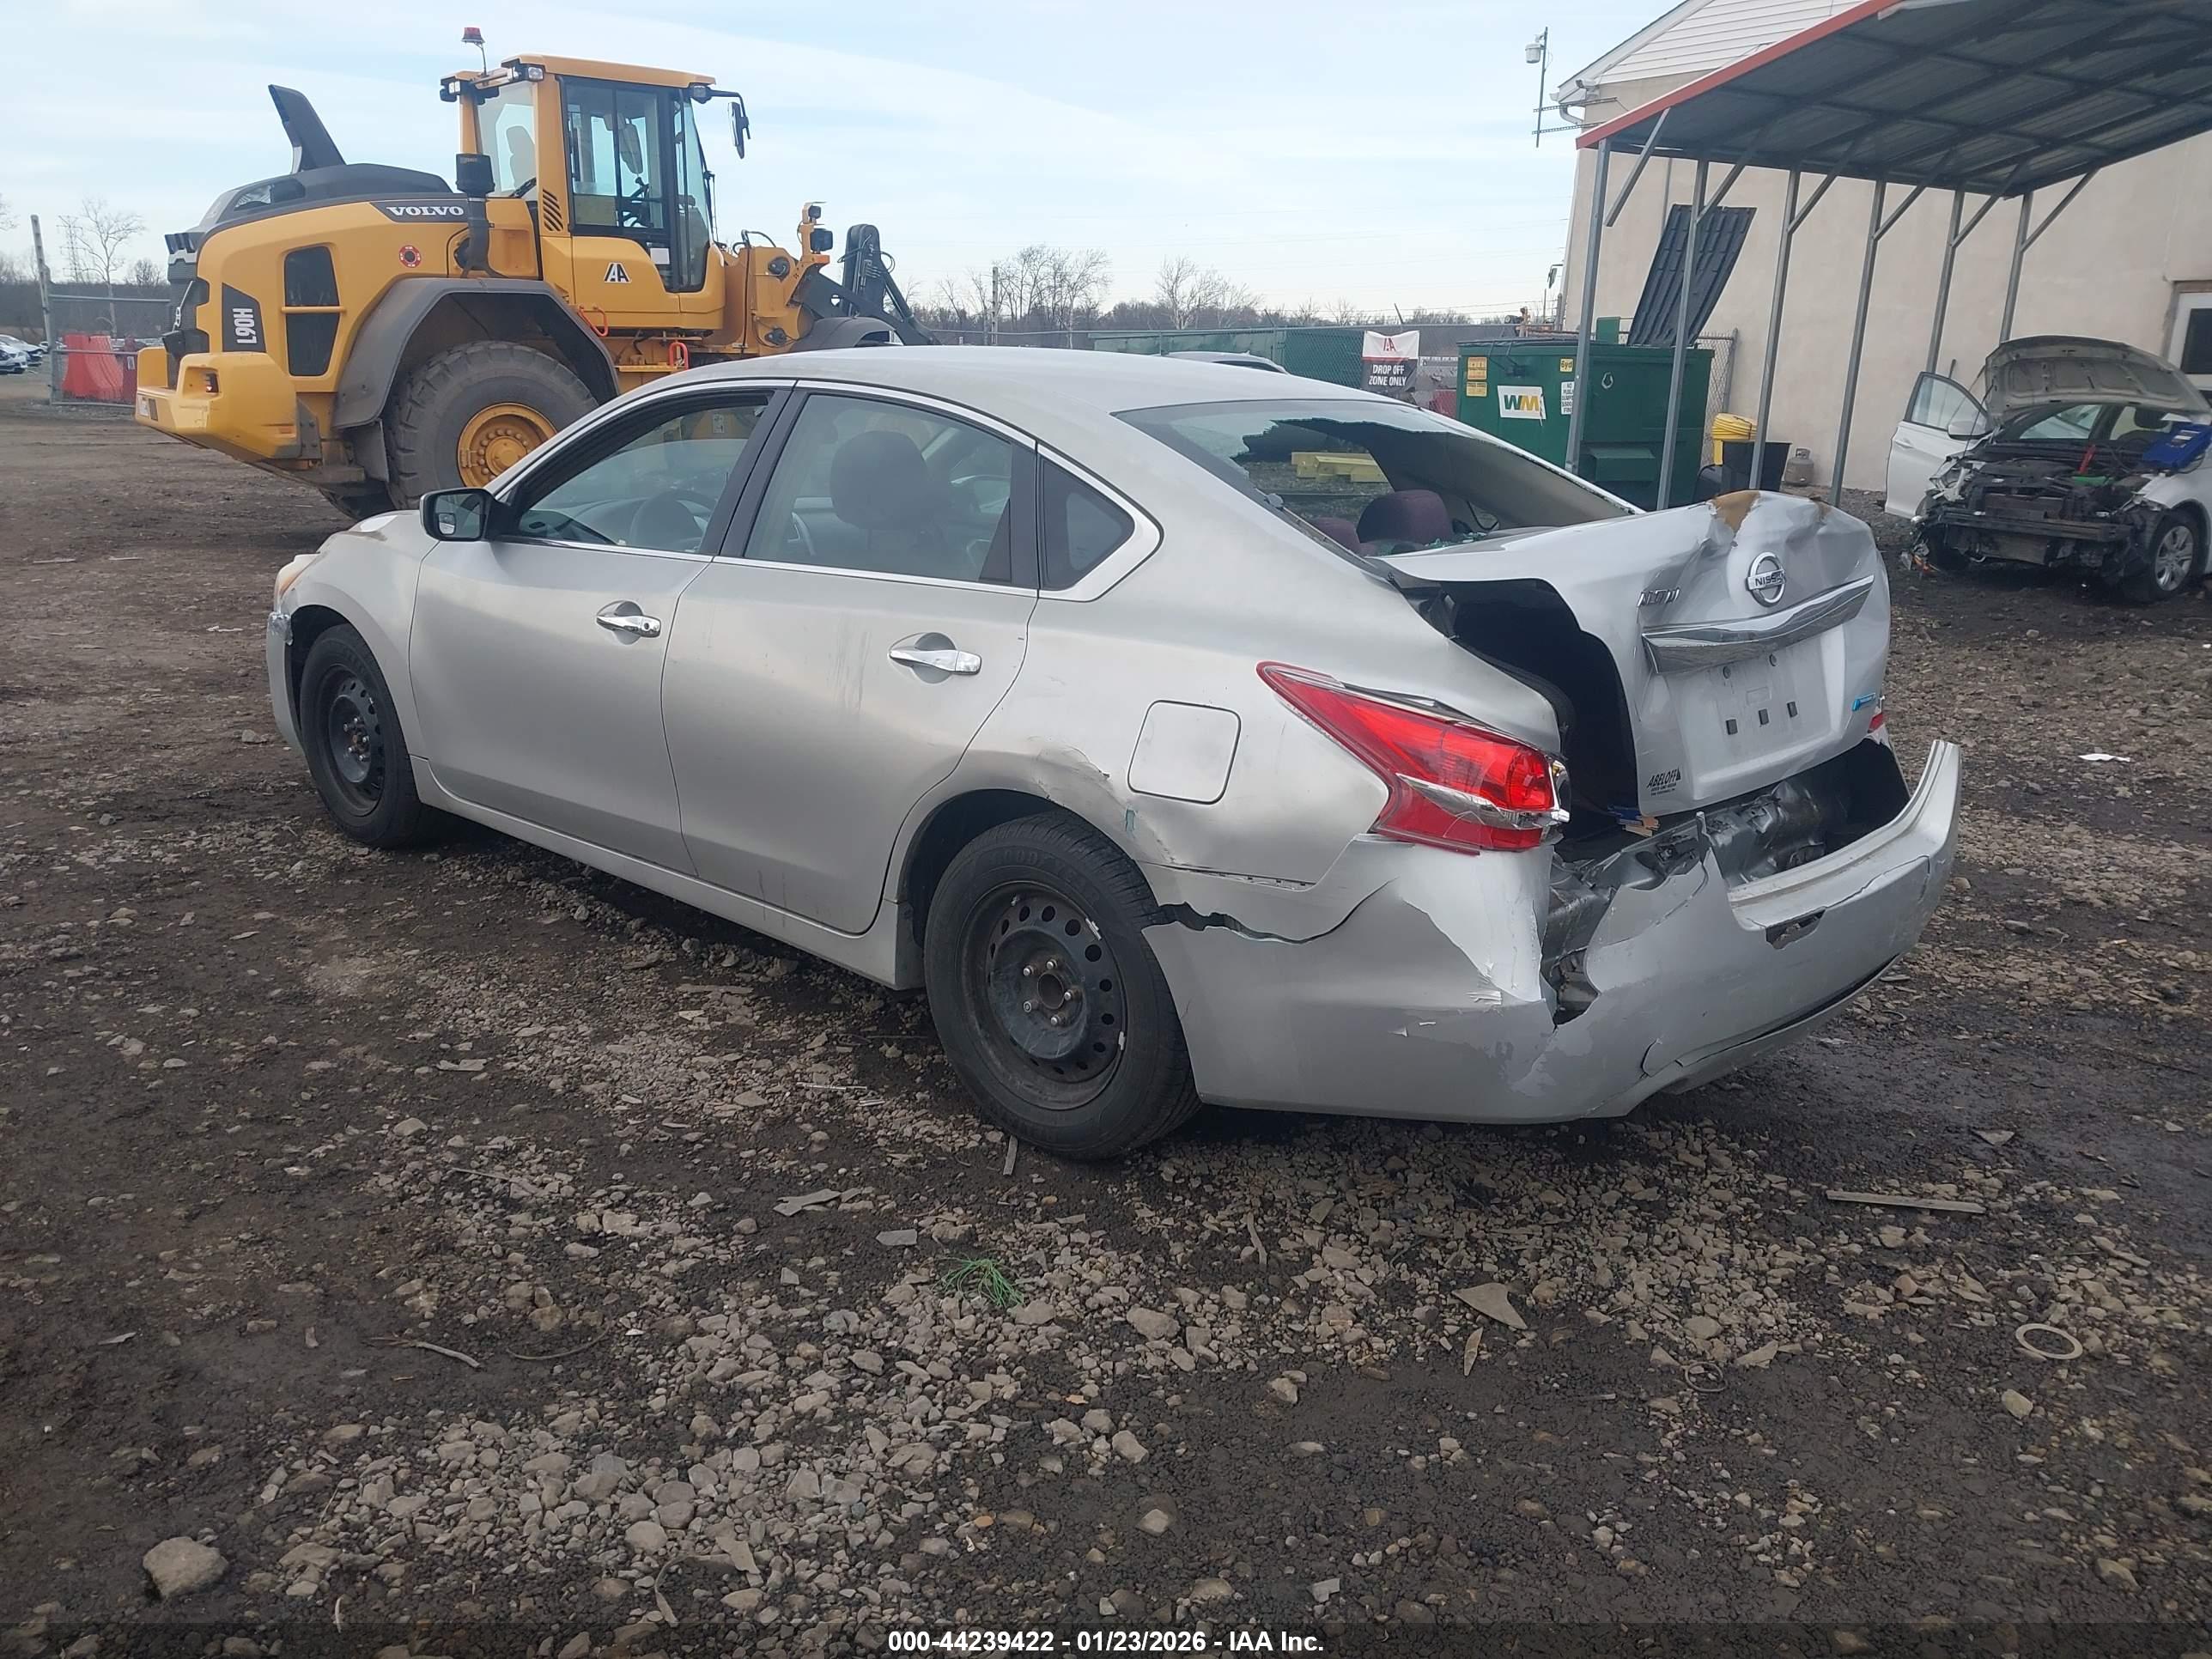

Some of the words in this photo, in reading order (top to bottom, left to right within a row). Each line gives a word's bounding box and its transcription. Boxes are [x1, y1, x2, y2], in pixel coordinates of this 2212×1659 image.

[386, 206, 465, 216] VOLVO
[232, 307, 258, 343] L90H
[1372, 364, 1392, 375] DROP
[1393, 365, 1405, 375] OFF
[1368, 375, 1388, 386] ZONE
[1389, 376, 1407, 386] ONLY
[1504, 394, 1540, 411] WM
